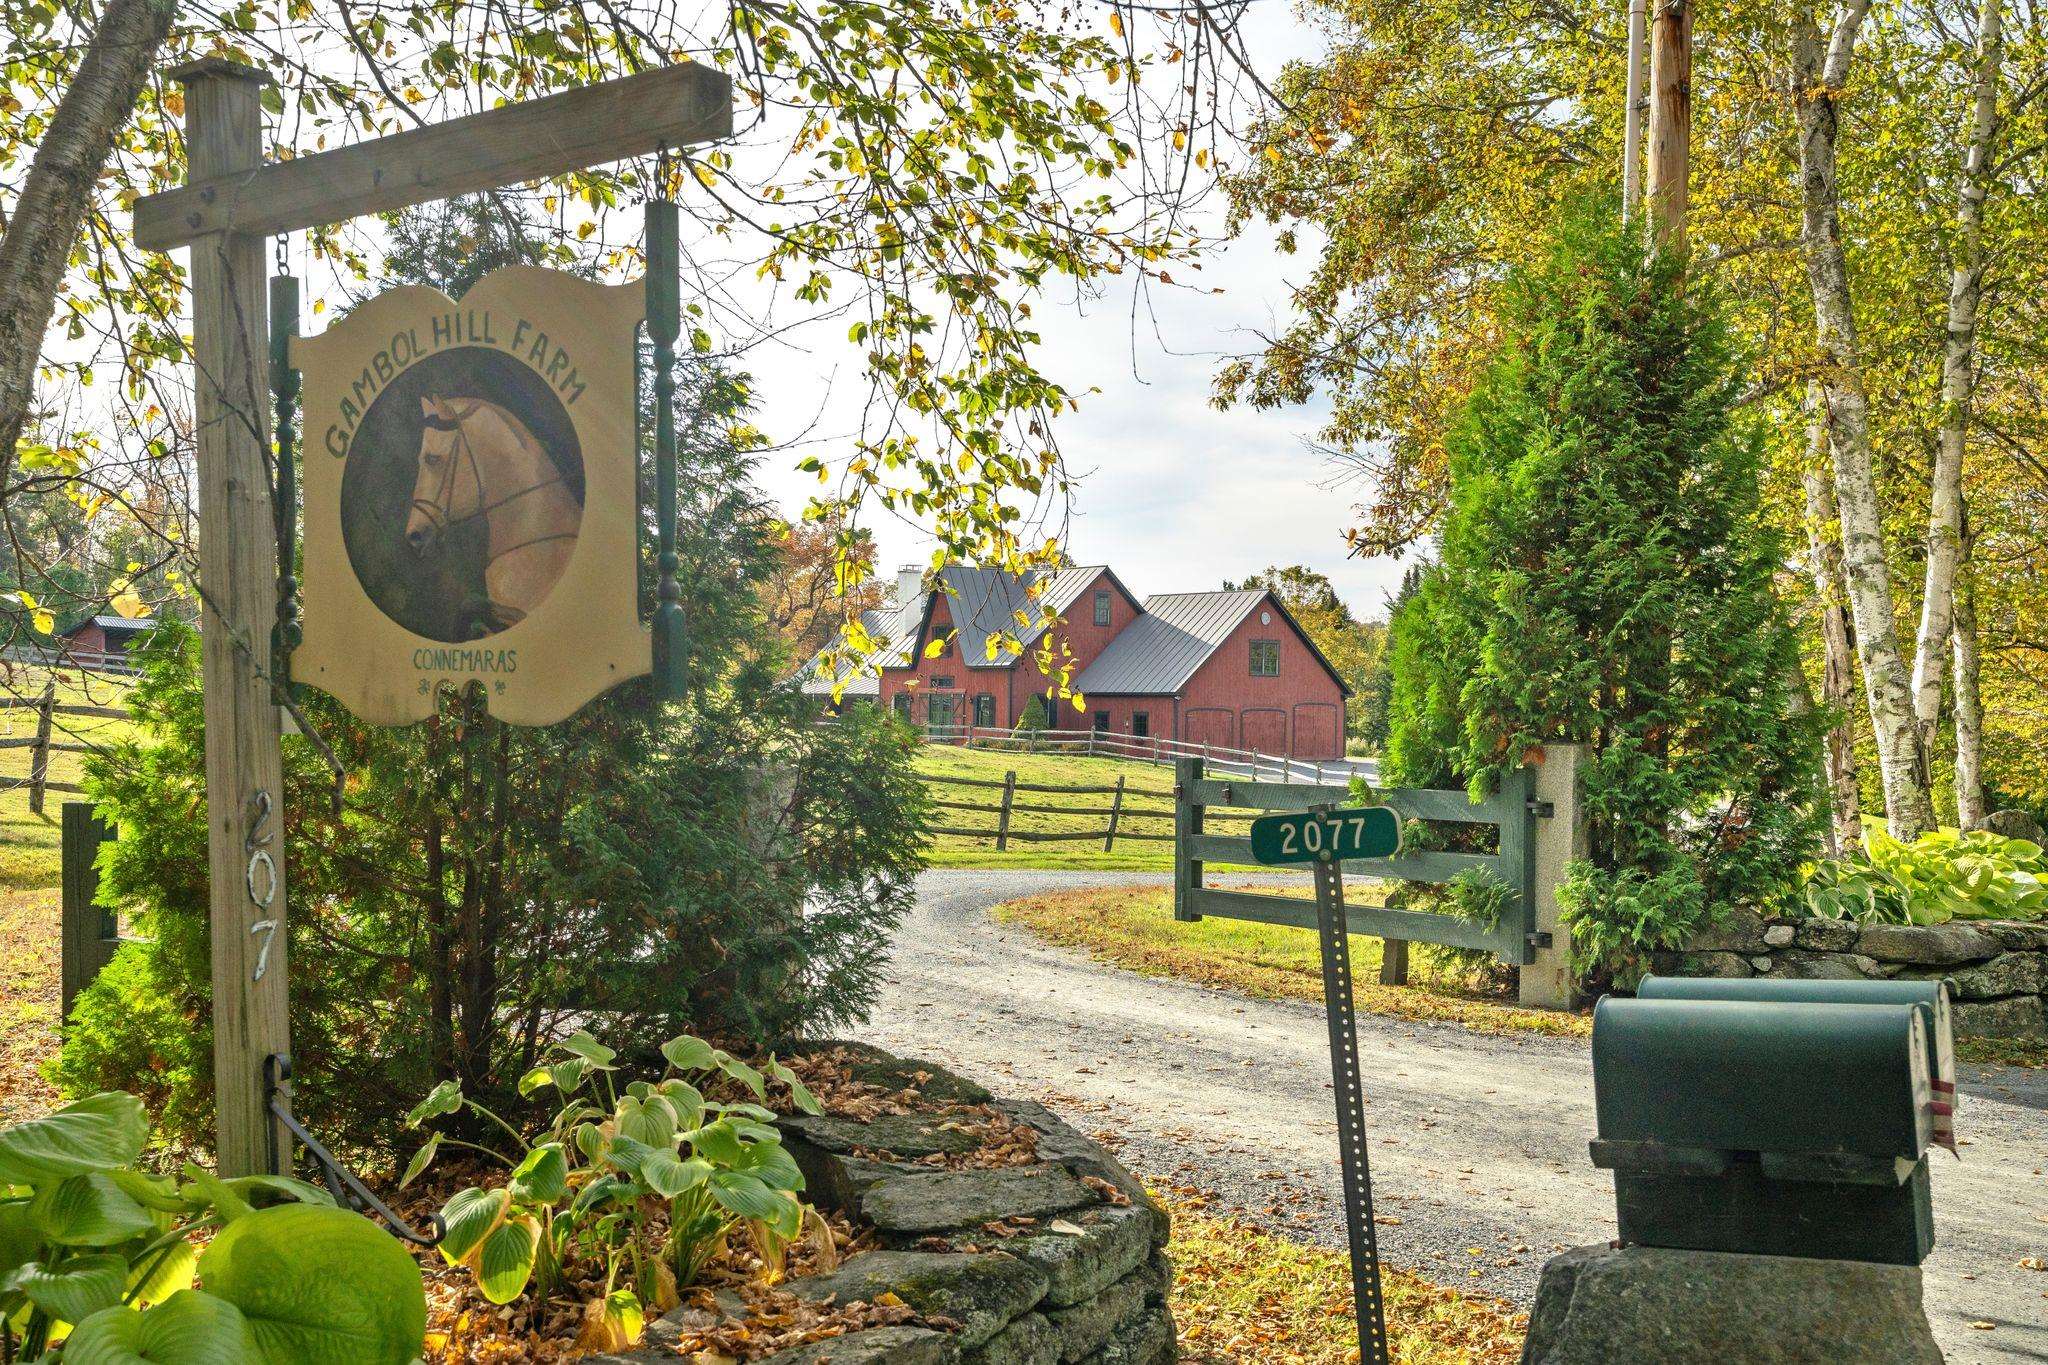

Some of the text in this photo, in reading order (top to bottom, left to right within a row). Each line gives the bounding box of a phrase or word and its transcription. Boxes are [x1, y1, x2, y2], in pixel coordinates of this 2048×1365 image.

[325, 310, 587, 459] GAMBOL HILL FARM
[413, 648, 517, 673] CONNEMARAS
[1280, 818, 1365, 854] 2077
[246, 791, 277, 982] 207
